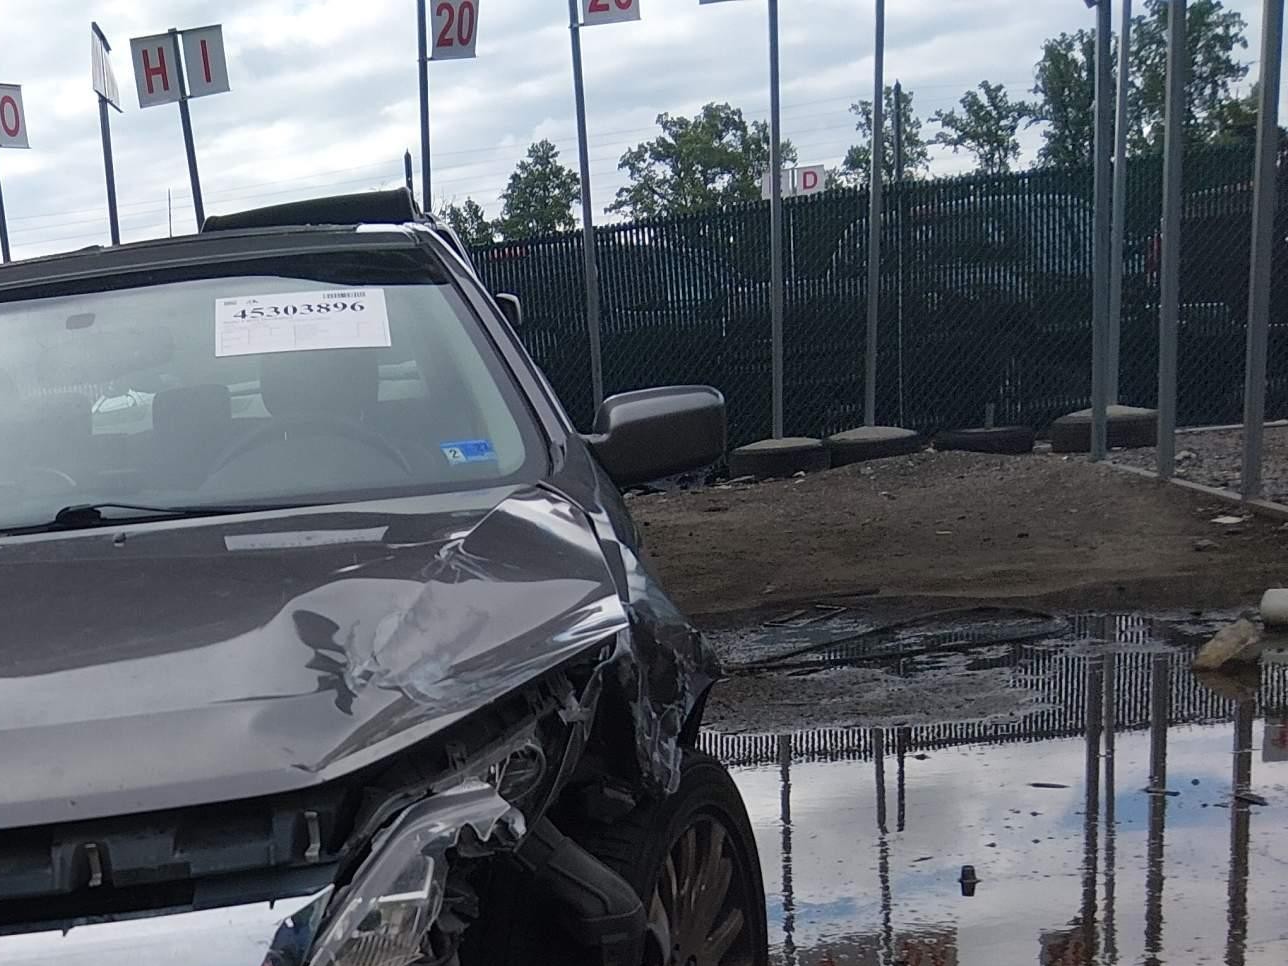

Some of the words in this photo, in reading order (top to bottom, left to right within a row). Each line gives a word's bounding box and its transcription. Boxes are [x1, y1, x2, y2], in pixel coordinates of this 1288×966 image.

[436, 1, 474, 47] 20
[142, 46, 169, 94] H
[200, 39, 212, 83] I
[0, 95, 20, 137] O
[802, 170, 818, 190] D
[233, 301, 365, 320] 45303896
